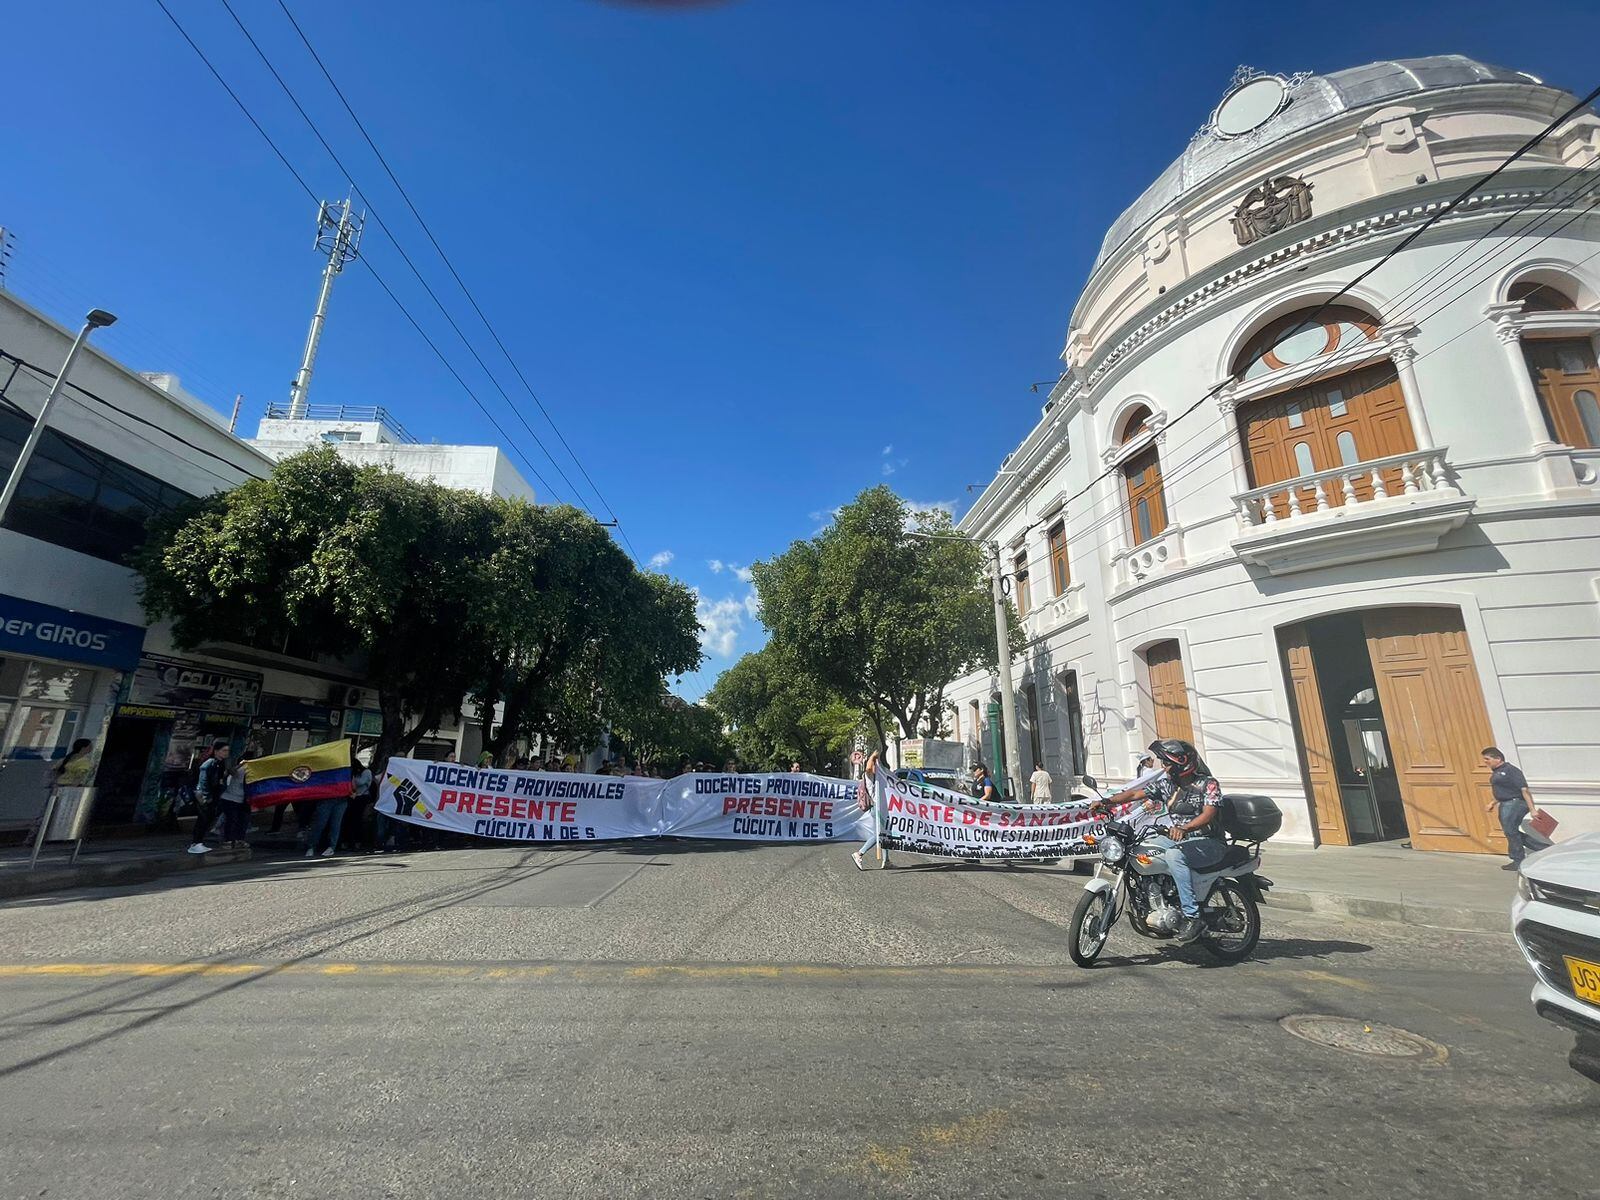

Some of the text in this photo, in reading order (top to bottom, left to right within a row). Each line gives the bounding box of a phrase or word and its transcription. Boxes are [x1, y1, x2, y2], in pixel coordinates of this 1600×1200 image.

[425, 765, 626, 800] DOCENTES PROVISIONALES
[695, 777, 859, 800] DOCENTES PROVISIONALES
[437, 789, 577, 822] PRESENTE
[722, 797, 833, 820] PRESENTE
[888, 793, 955, 823] NORTE
[962, 809, 992, 826] DE
[474, 817, 536, 839] CÚCUTA
[560, 826, 580, 839] DE
[733, 816, 782, 836] CÚCUTA
[803, 822, 819, 838] DE
[916, 821, 936, 838] PAZ
[936, 825, 971, 842] TOTAL
[974, 830, 999, 843] CON
[1001, 826, 1079, 842] ESTABILIDAD
